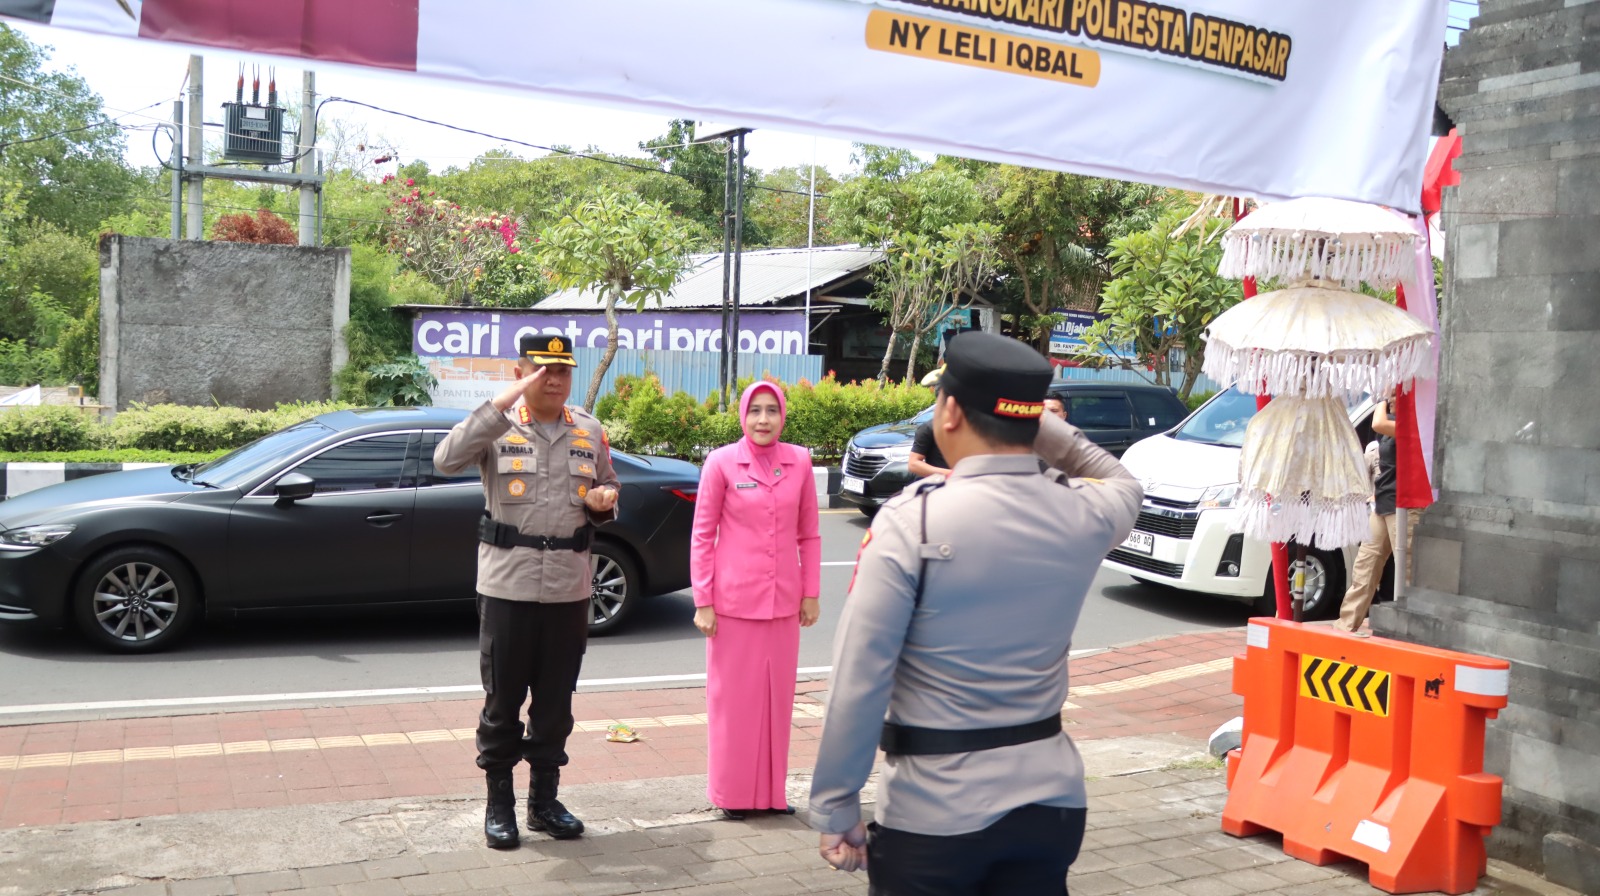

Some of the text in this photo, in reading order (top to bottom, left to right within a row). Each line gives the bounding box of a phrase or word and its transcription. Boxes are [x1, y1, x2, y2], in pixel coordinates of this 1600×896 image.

[889, 18, 1083, 79] NY LELI IQBAL
[1070, 0, 1186, 53] POLRESTA
[1191, 18, 1290, 77] DENPASAR
[417, 314, 500, 356] cari
[587, 320, 663, 350] cari
[443, 389, 471, 398] PANTI
[474, 390, 495, 399] SARI
[569, 449, 594, 460] POLRI
